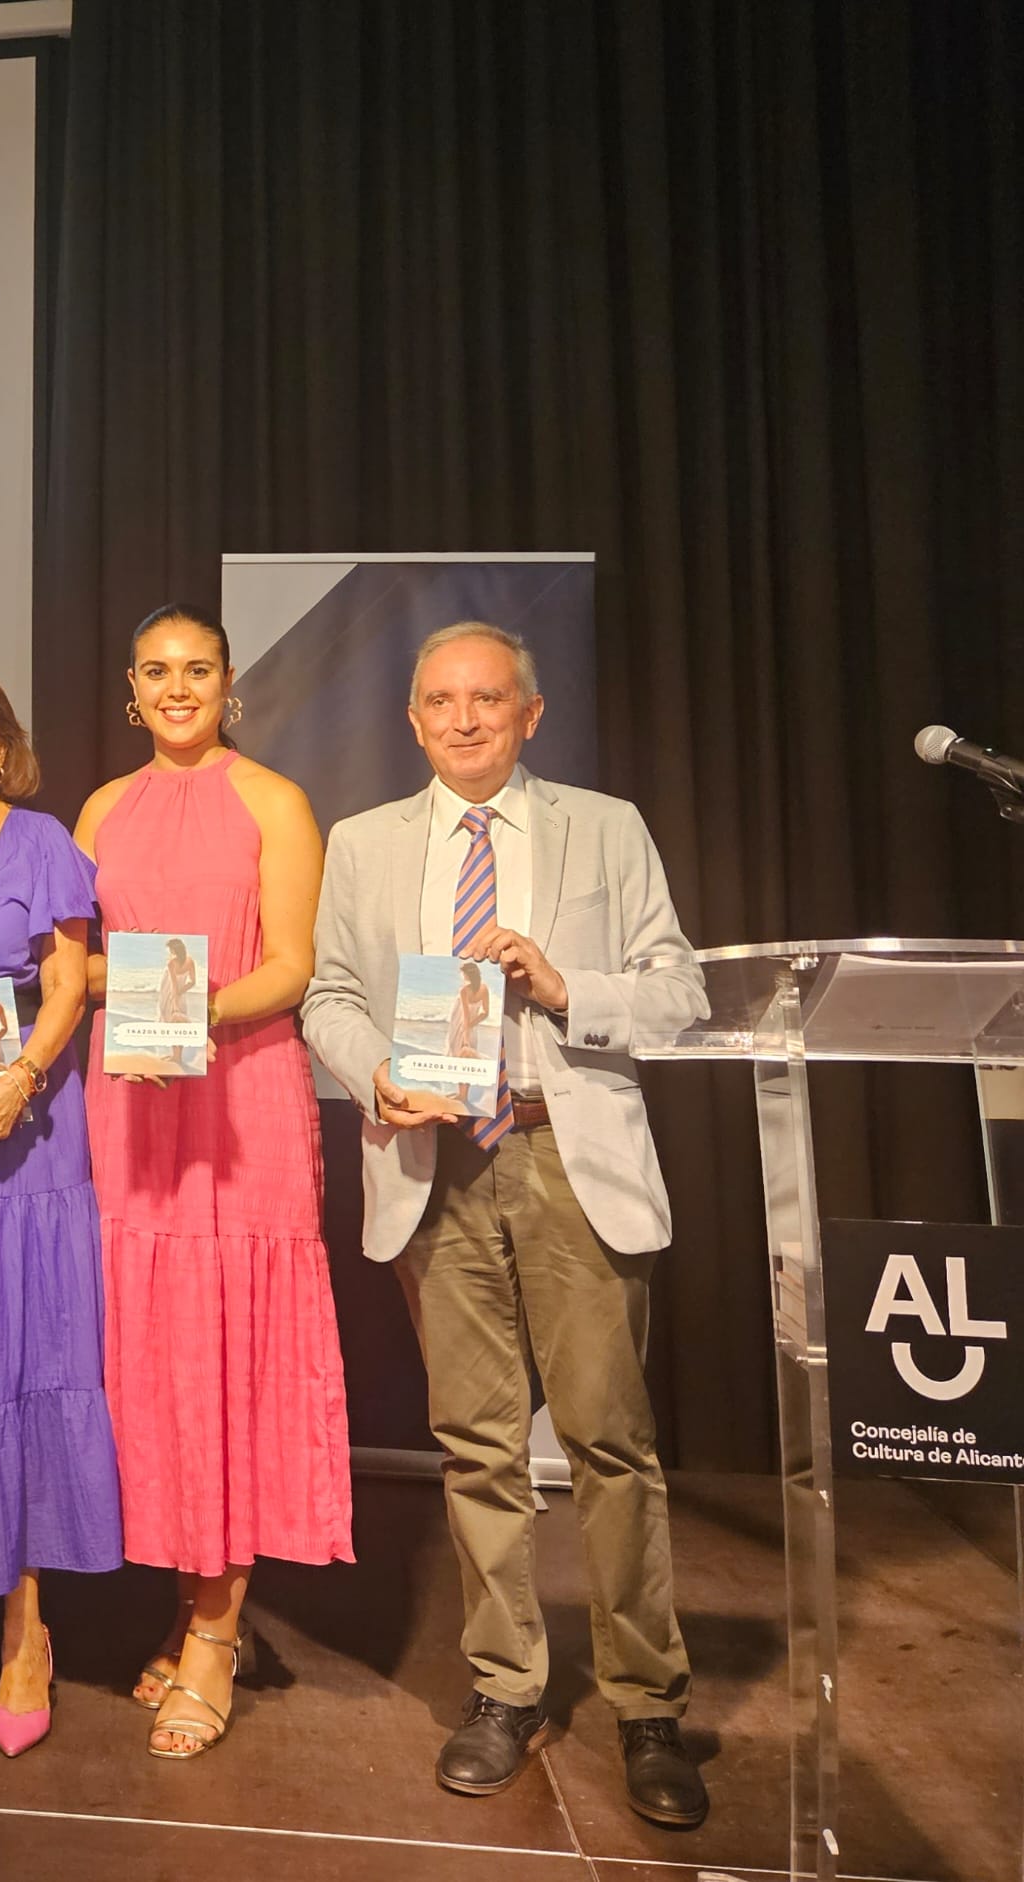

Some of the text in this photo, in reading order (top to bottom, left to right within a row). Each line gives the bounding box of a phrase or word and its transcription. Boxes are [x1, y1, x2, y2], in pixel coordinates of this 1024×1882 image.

[127, 1028, 158, 1036] TRAZOS
[160, 1028, 170, 1036] DE
[174, 1029, 198, 1037] VIDAS
[412, 1060, 445, 1071] TRAZOS
[447, 1063, 458, 1072] DE
[864, 1253, 1008, 1340] AL
[850, 1420, 977, 1446] Concejalía de
[852, 1441, 1024, 1469] Cultura de Alicant
